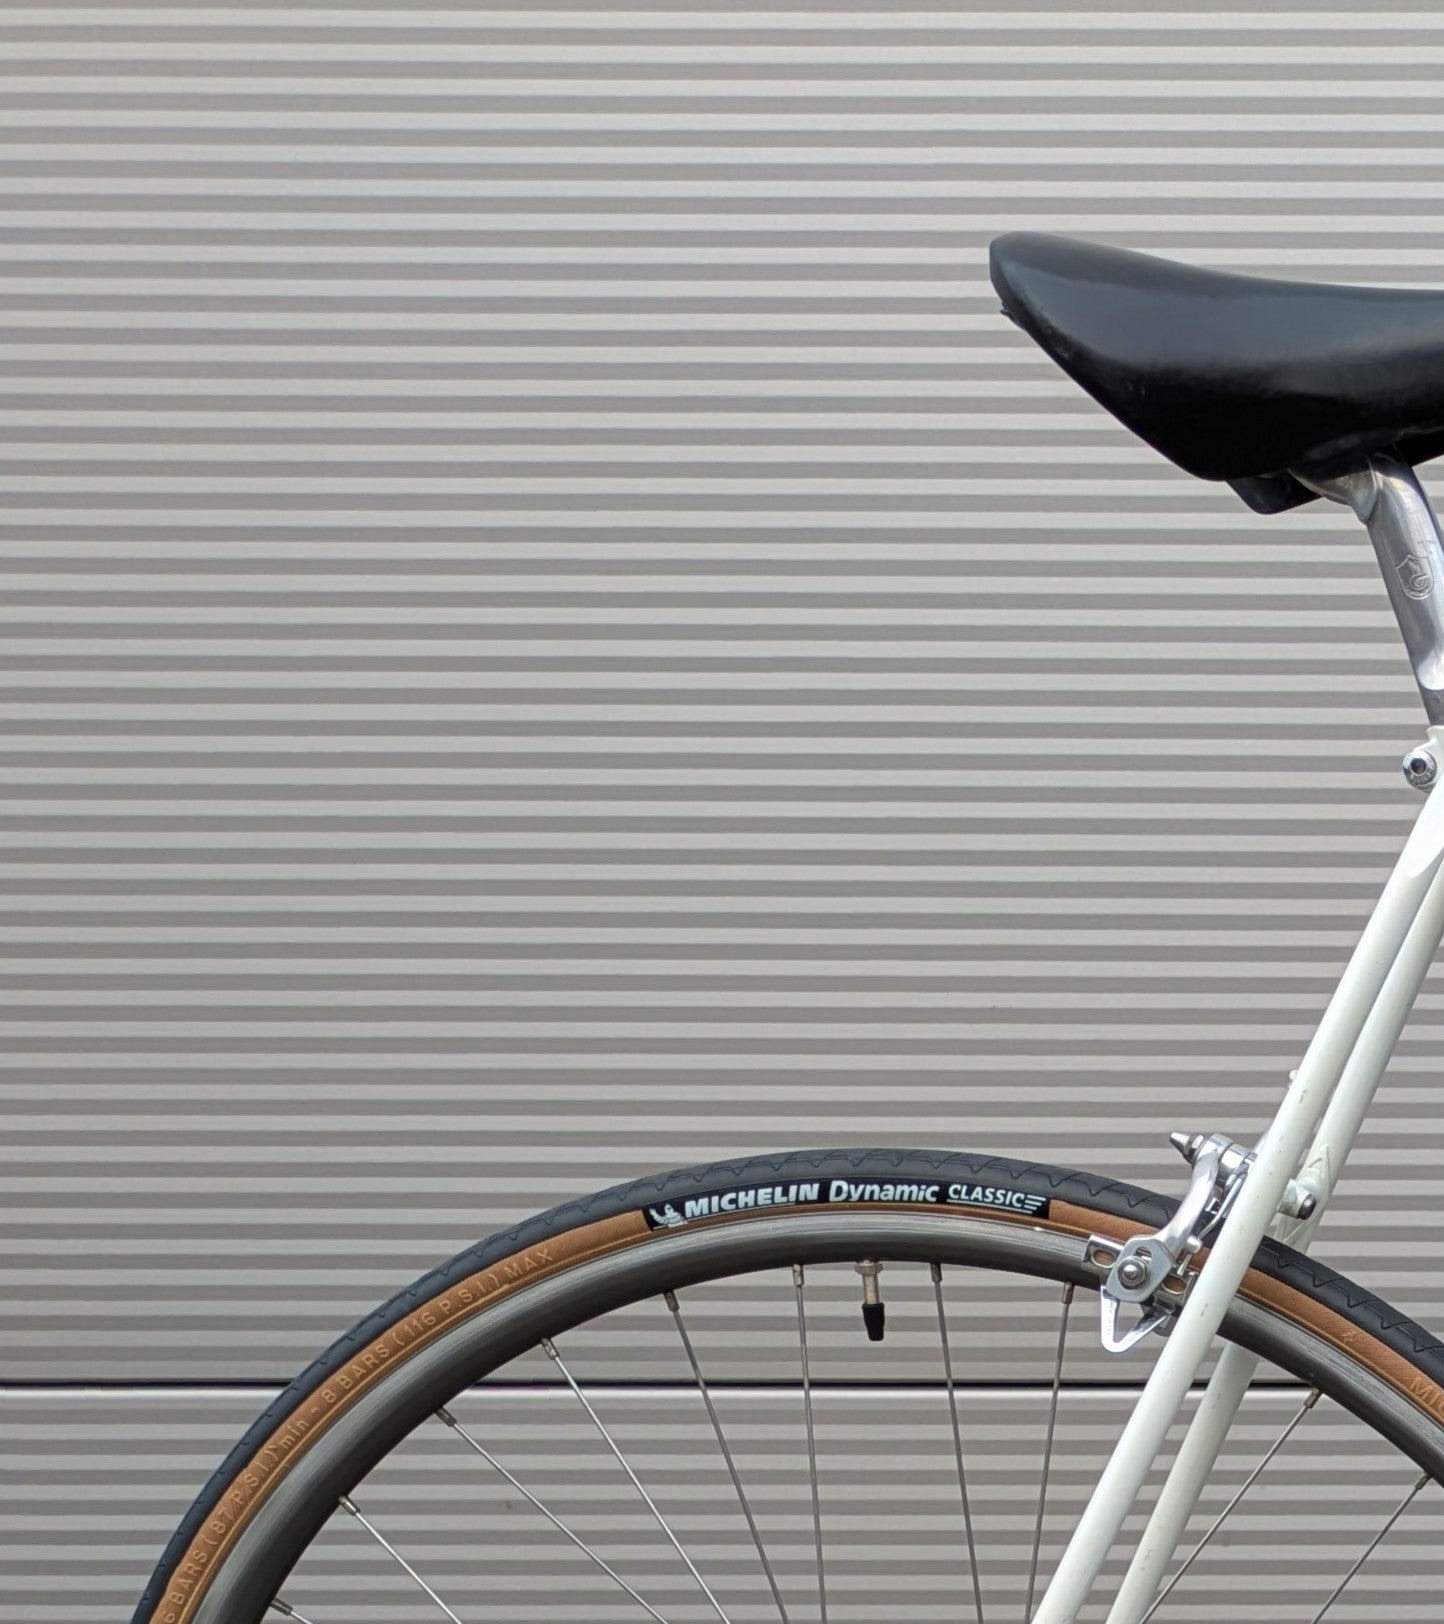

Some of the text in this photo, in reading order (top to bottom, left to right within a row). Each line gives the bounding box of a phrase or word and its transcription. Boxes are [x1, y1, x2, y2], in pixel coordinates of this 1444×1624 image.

[684, 1179, 1025, 1219] MICHELIN Dynamic CLASSIC
[159, 1608, 177, 1624] 6
[168, 1547, 209, 1605] BARS
[336, 1341, 391, 1390] BARS
[503, 1247, 554, 1279] MAX
